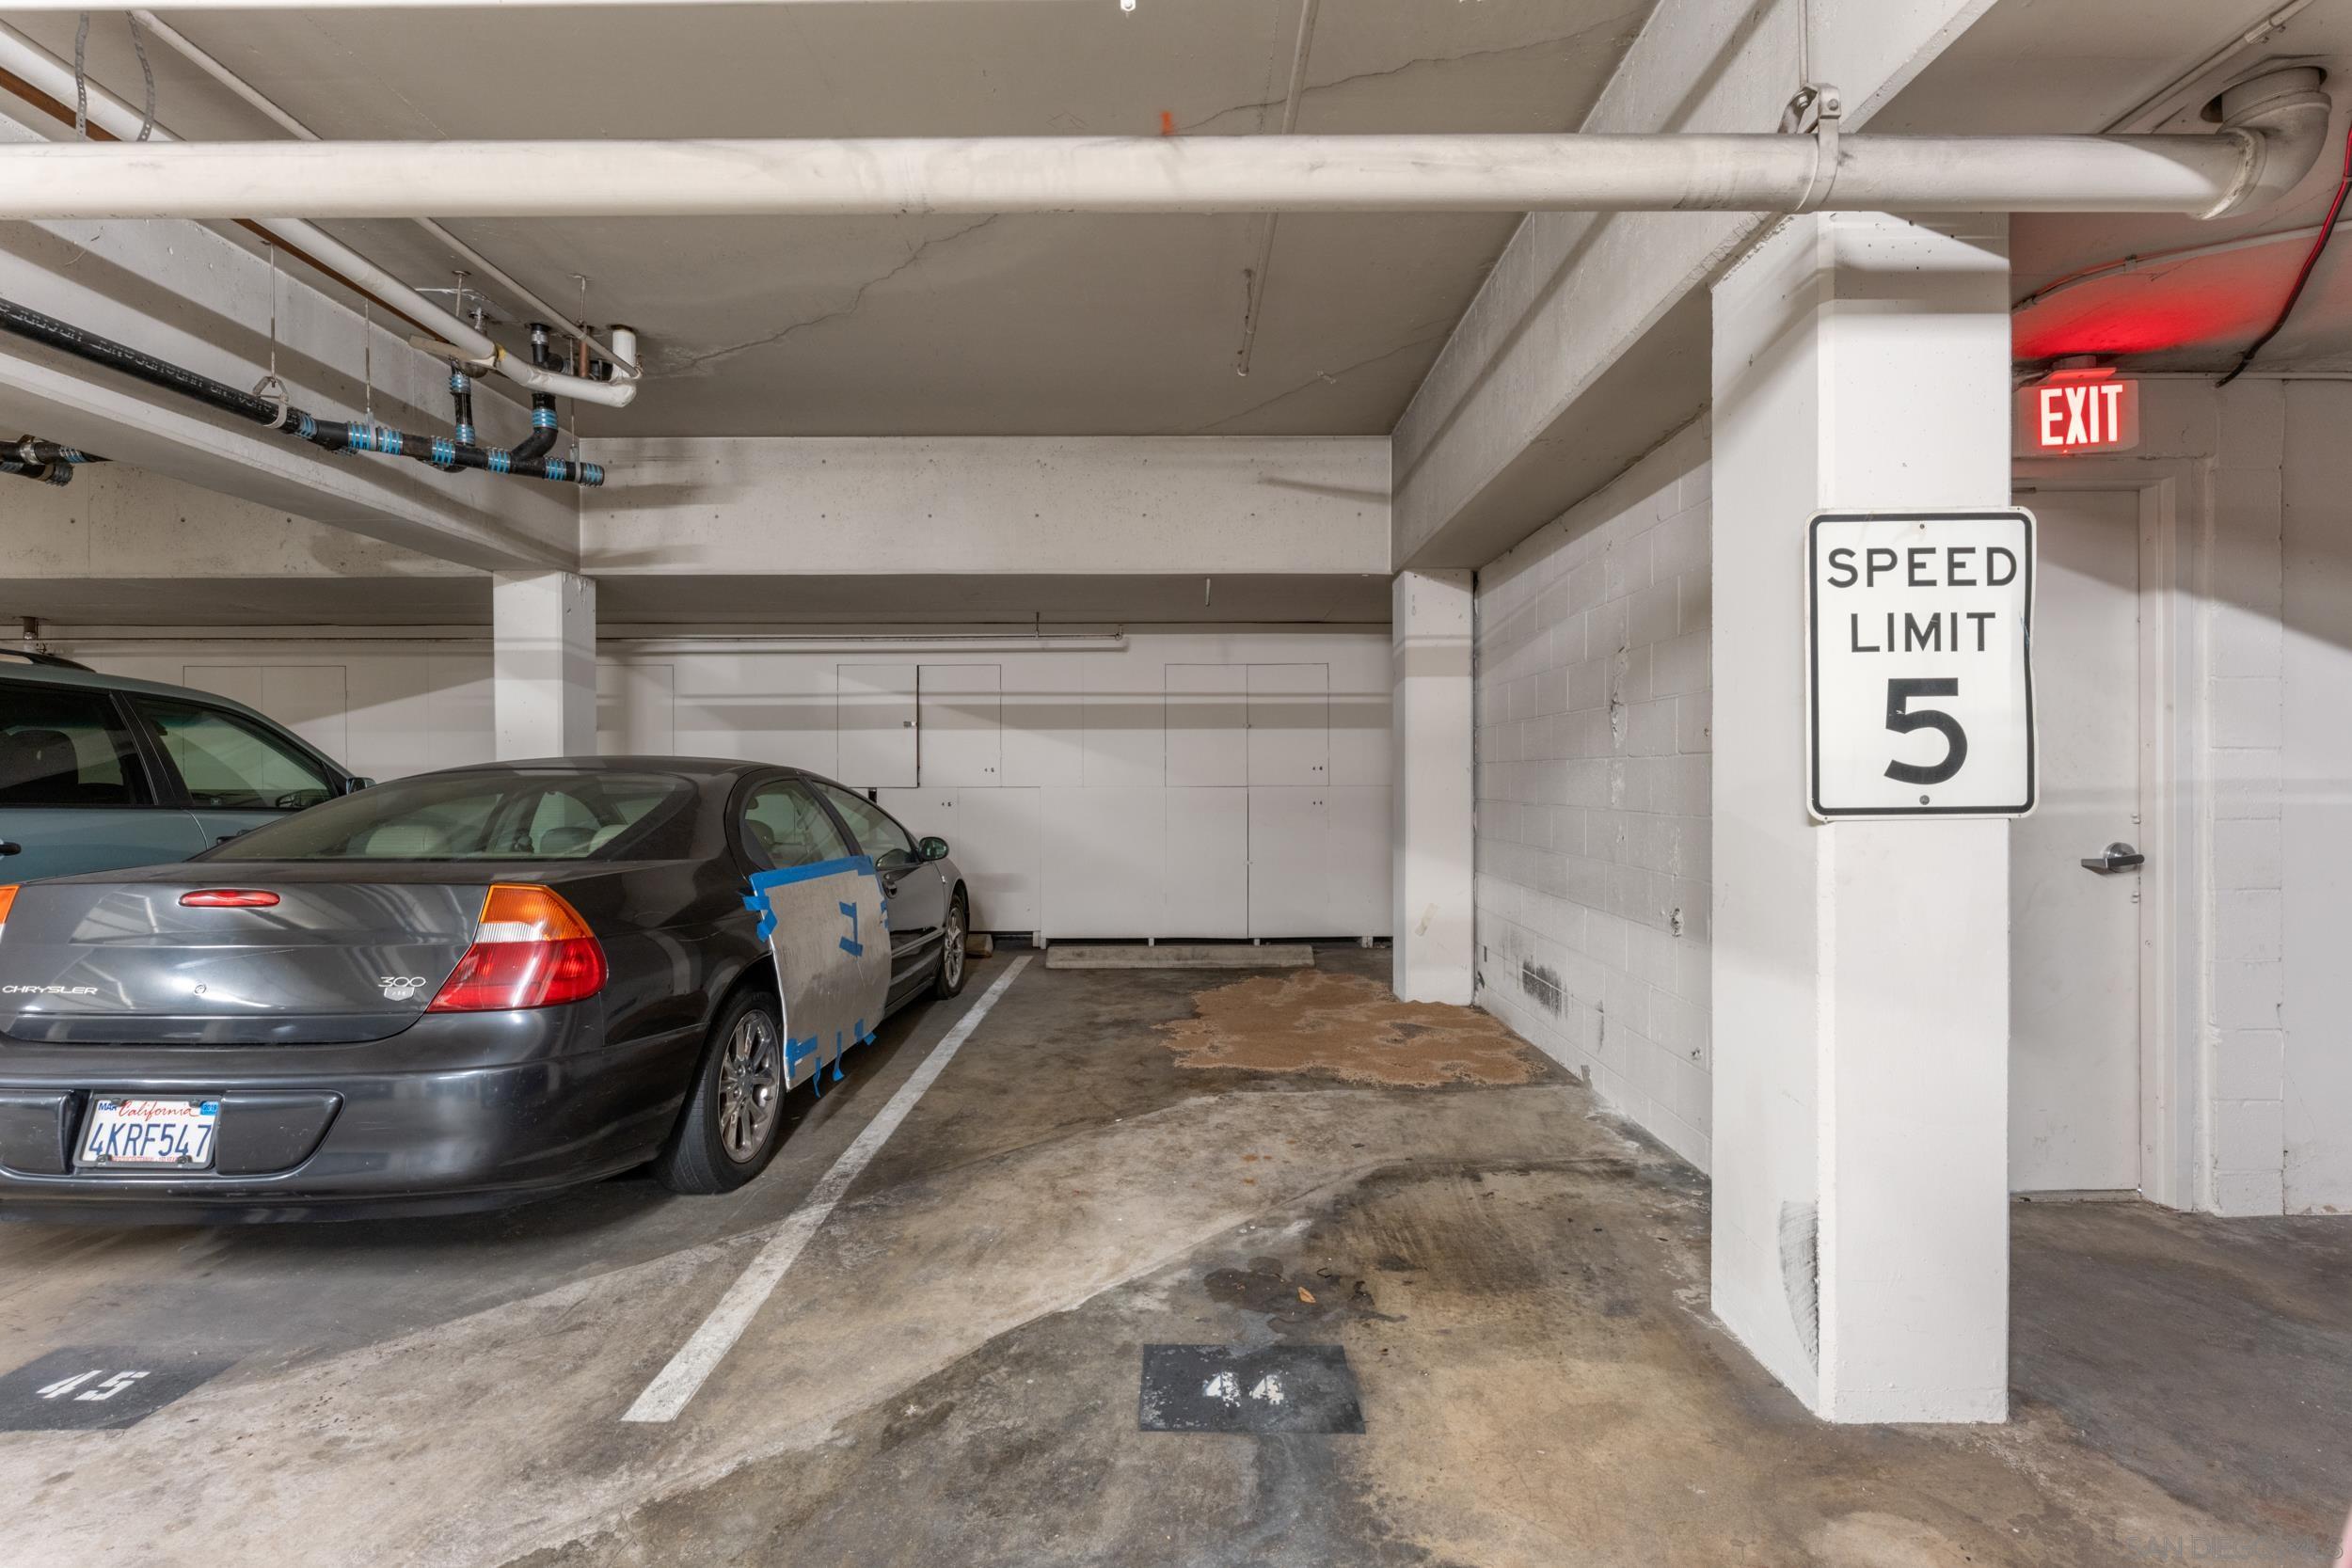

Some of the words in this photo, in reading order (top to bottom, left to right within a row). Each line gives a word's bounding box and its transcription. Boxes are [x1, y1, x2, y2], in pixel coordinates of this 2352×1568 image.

[2040, 384, 2123, 446] EXIT
[1827, 546, 2017, 588] SPEED
[1851, 612, 1995, 653] LIMIT
[1883, 677, 1968, 784] 5
[2, 985, 99, 995] CHRYSLER
[378, 976, 426, 988] 300
[119, 1099, 201, 1121] California
[88, 1122, 213, 1158] 4KRF547
[36, 1370, 151, 1401] 45
[1202, 1370, 1285, 1408] 44
